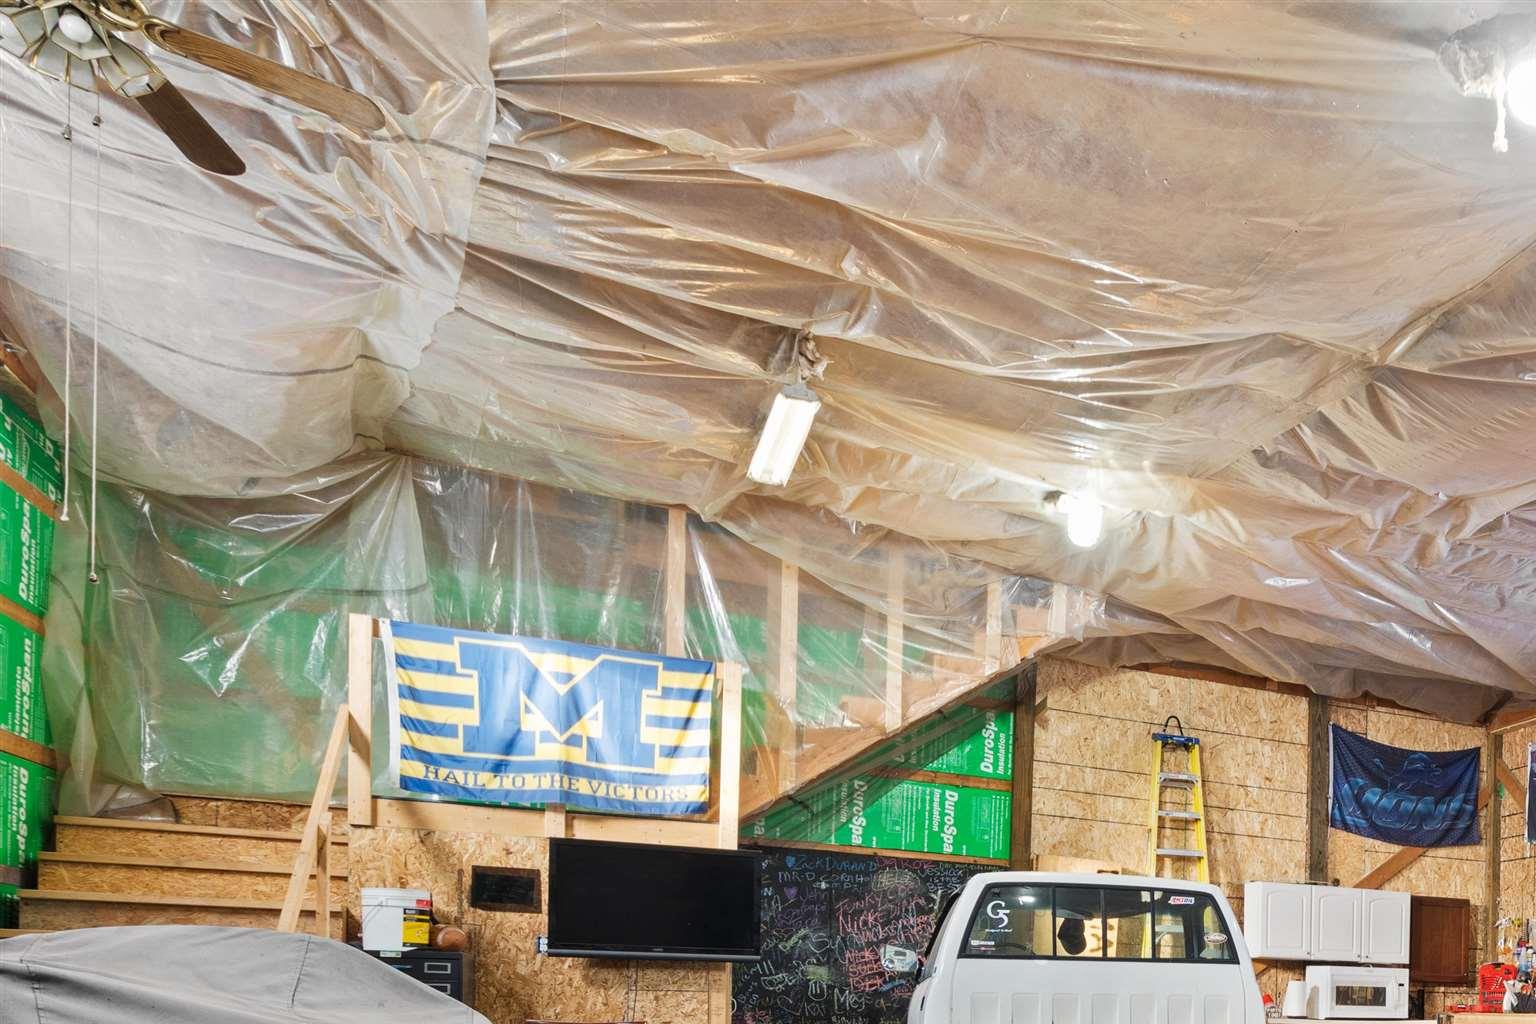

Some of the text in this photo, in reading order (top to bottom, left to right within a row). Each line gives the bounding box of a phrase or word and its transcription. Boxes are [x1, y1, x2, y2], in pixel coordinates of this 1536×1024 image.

[19, 497, 31, 601] DuroSpa
[454, 636, 663, 772] M
[423, 765, 688, 801] HAIL TO THE VICTORS
[996, 733, 1006, 774] Insulation
[18, 767, 29, 869] DuroSpa
[932, 789, 942, 832] Insulation
[941, 789, 958, 854] DuroSpa
